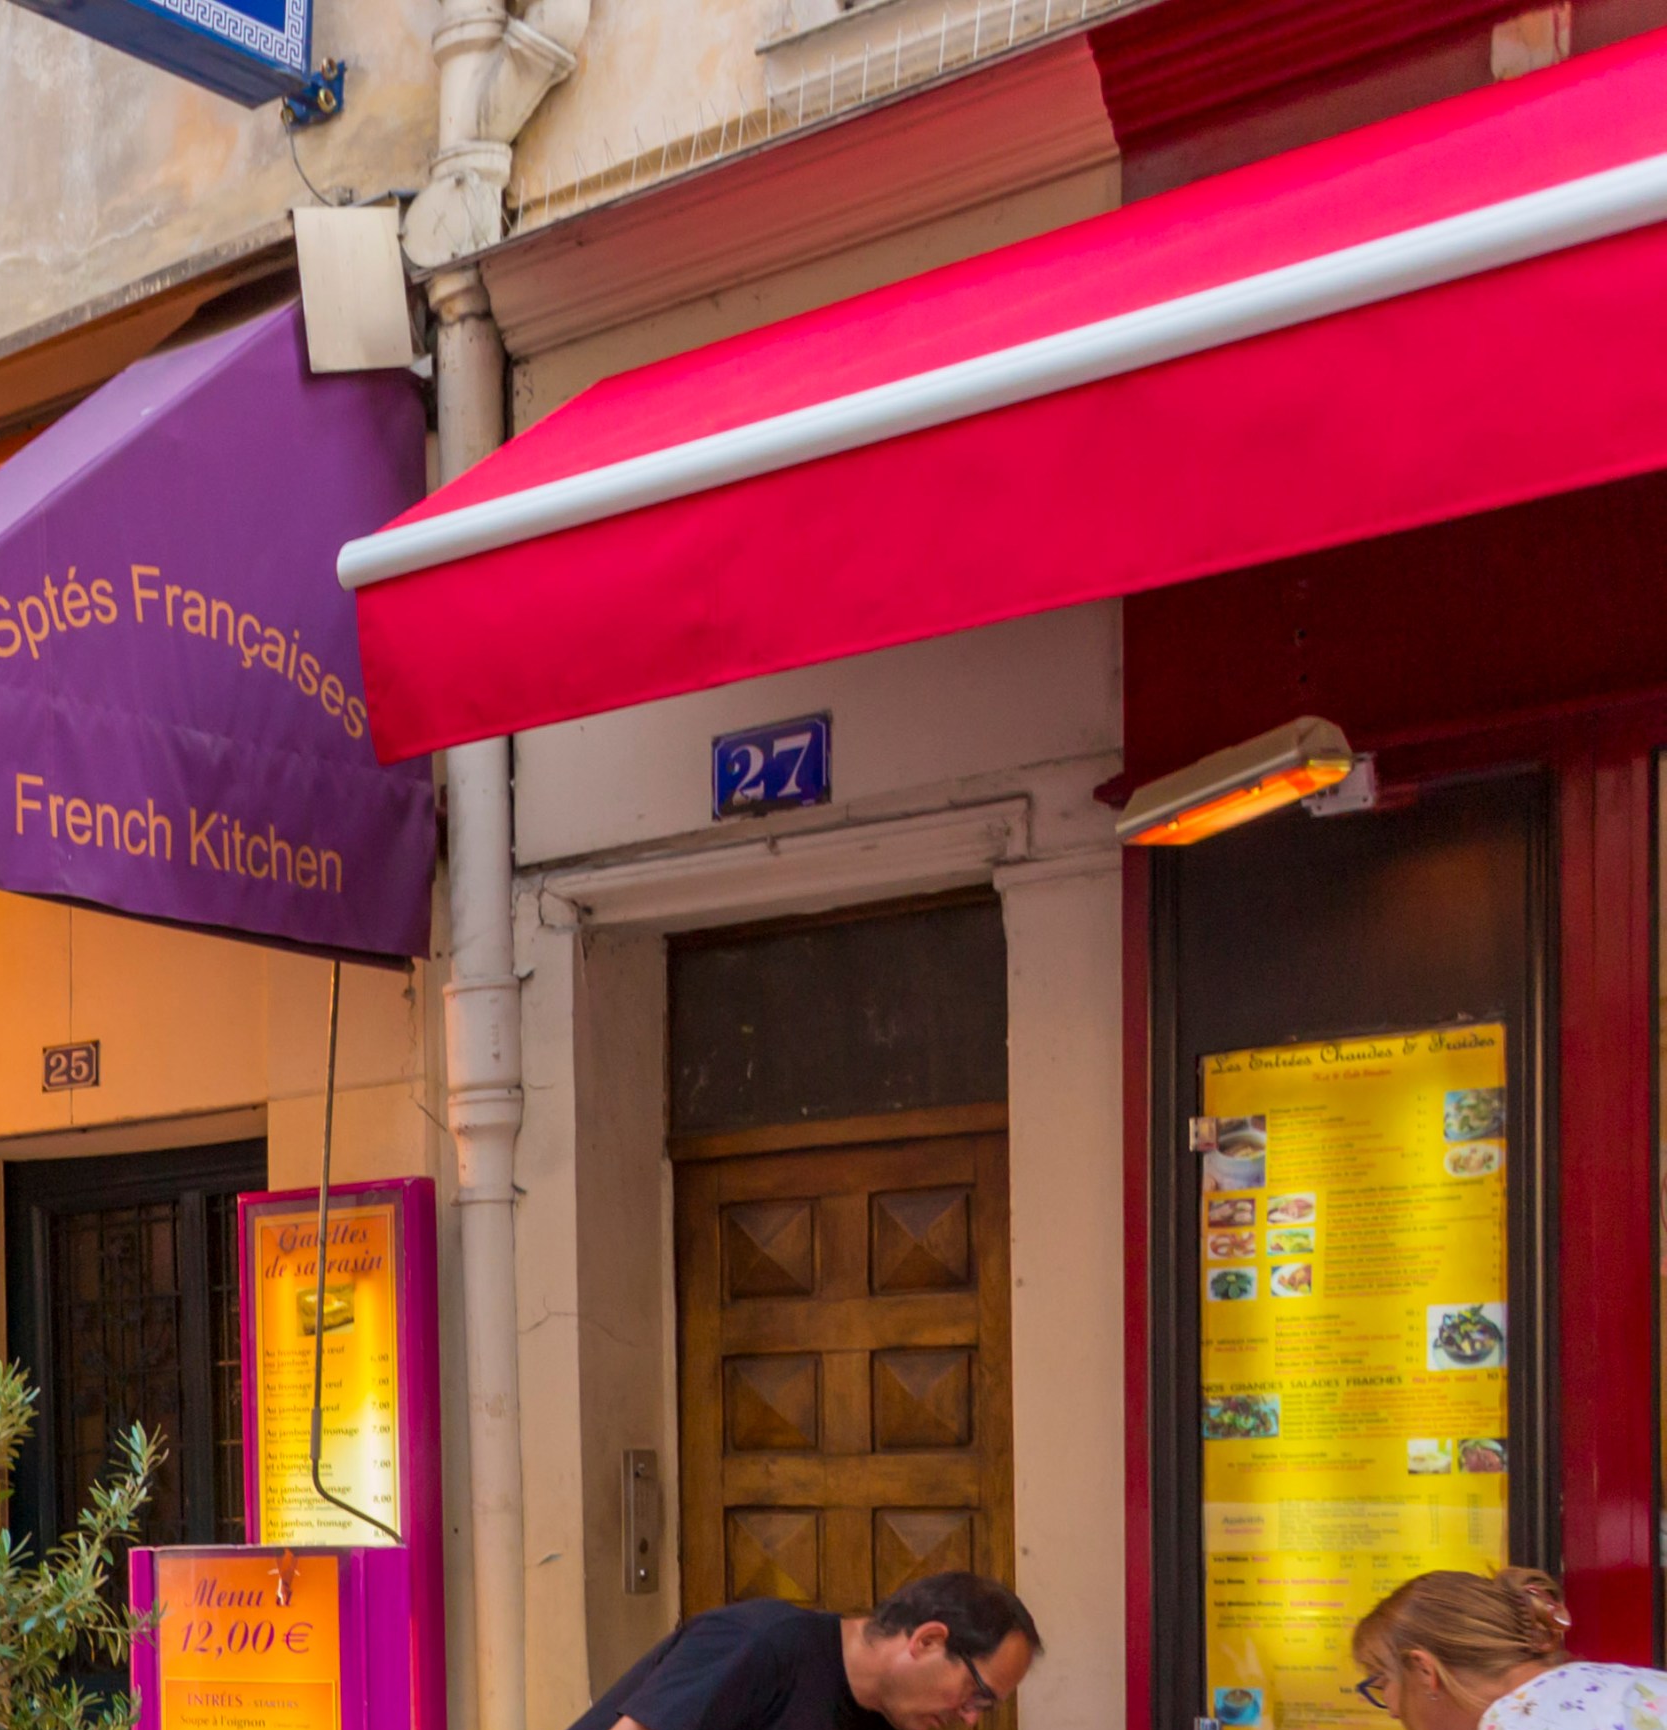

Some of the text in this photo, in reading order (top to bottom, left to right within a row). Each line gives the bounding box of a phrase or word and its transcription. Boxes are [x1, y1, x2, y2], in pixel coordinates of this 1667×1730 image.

[130, 564, 368, 740] Françaises
[729, 731, 813, 806] 27
[14, 773, 344, 894] French Kitchen
[49, 1050, 89, 1084] 25
[1211, 1058, 1241, 1074] Les
[1249, 1054, 1312, 1071] Entrées
[1320, 1043, 1393, 1066] Chaudes
[265, 1249, 383, 1279] de sarasin
[1230, 1381, 1283, 1393] GRANDES
[1290, 1378, 1340, 1390] SALADES
[185, 1577, 264, 1609] Menu
[181, 1619, 275, 1661] 12,00
[187, 1692, 244, 1708] ENTRÉES
[180, 1714, 210, 1728] Soupe
[220, 1715, 267, 1730] l'oignon
